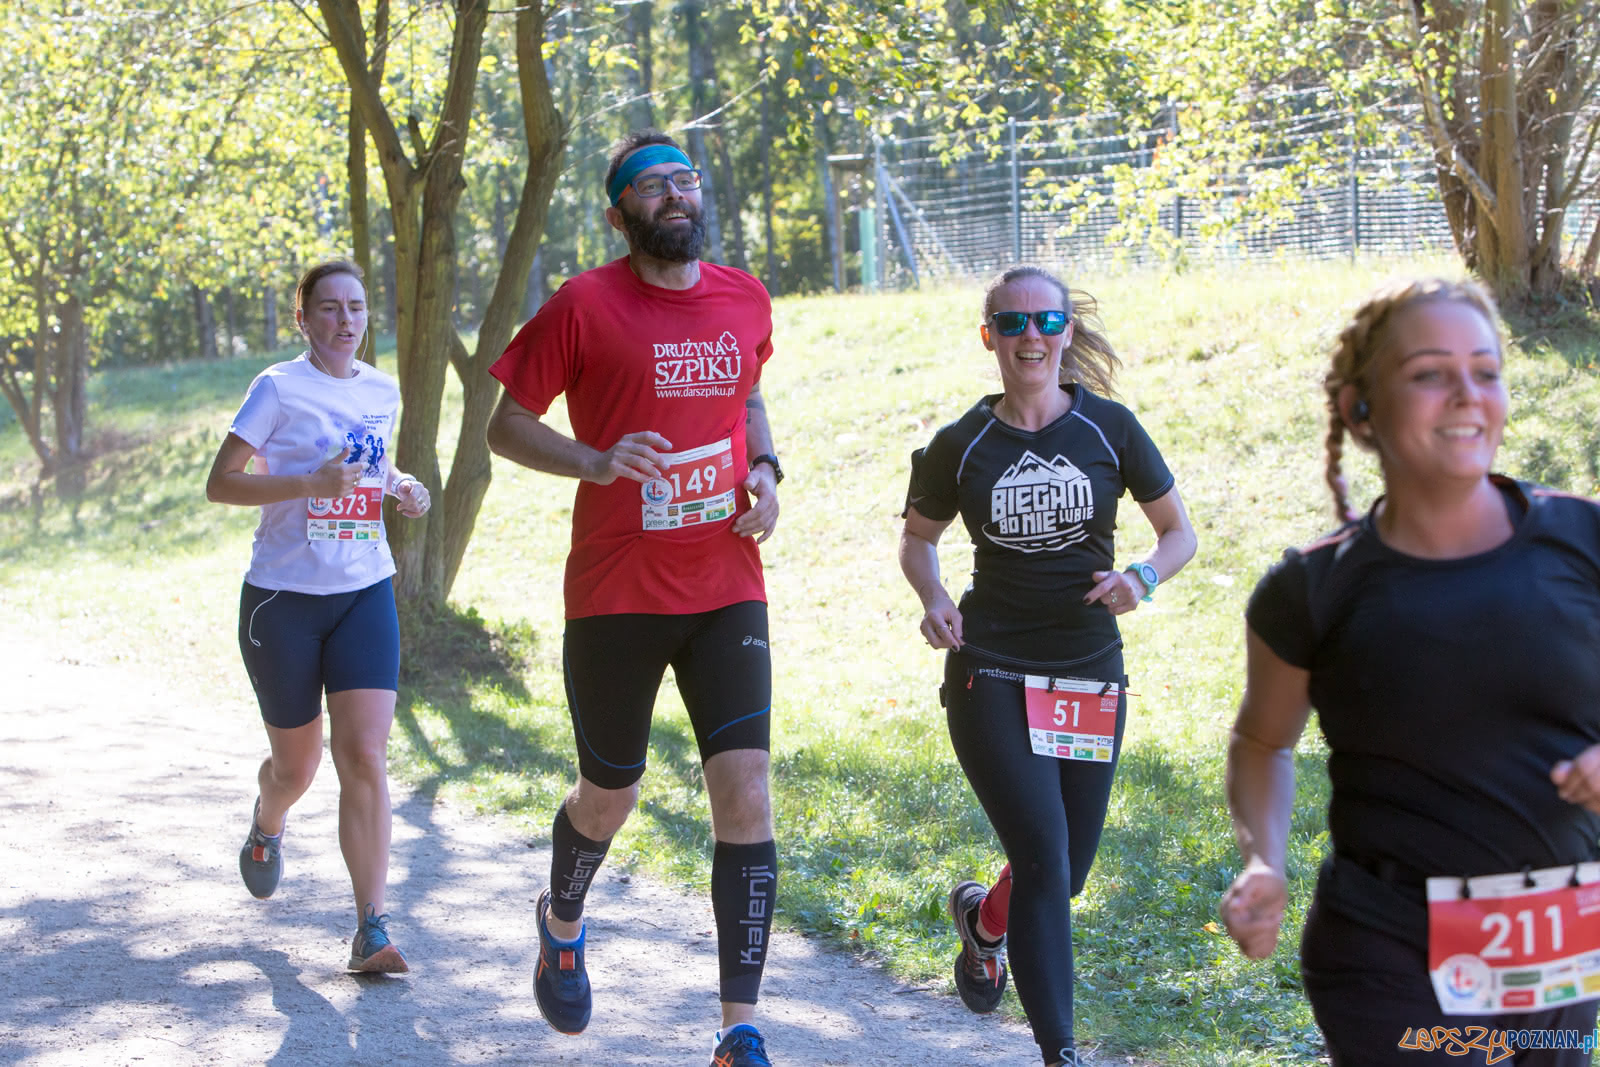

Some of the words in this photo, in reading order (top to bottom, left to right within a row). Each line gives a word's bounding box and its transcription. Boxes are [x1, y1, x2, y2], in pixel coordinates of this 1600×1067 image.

[653, 338, 726, 358] DRUŻYNA
[655, 356, 741, 385] SZPIKU
[656, 385, 736, 398] www.darszpiku.pl
[669, 465, 717, 498] 149
[331, 494, 367, 516] 373
[991, 477, 1094, 523] BIEGAM
[999, 516, 1019, 535] BO
[1022, 510, 1057, 536] NIE
[987, 673, 1023, 683] recovery
[1053, 699, 1081, 728] 51
[1480, 904, 1563, 959] 211
